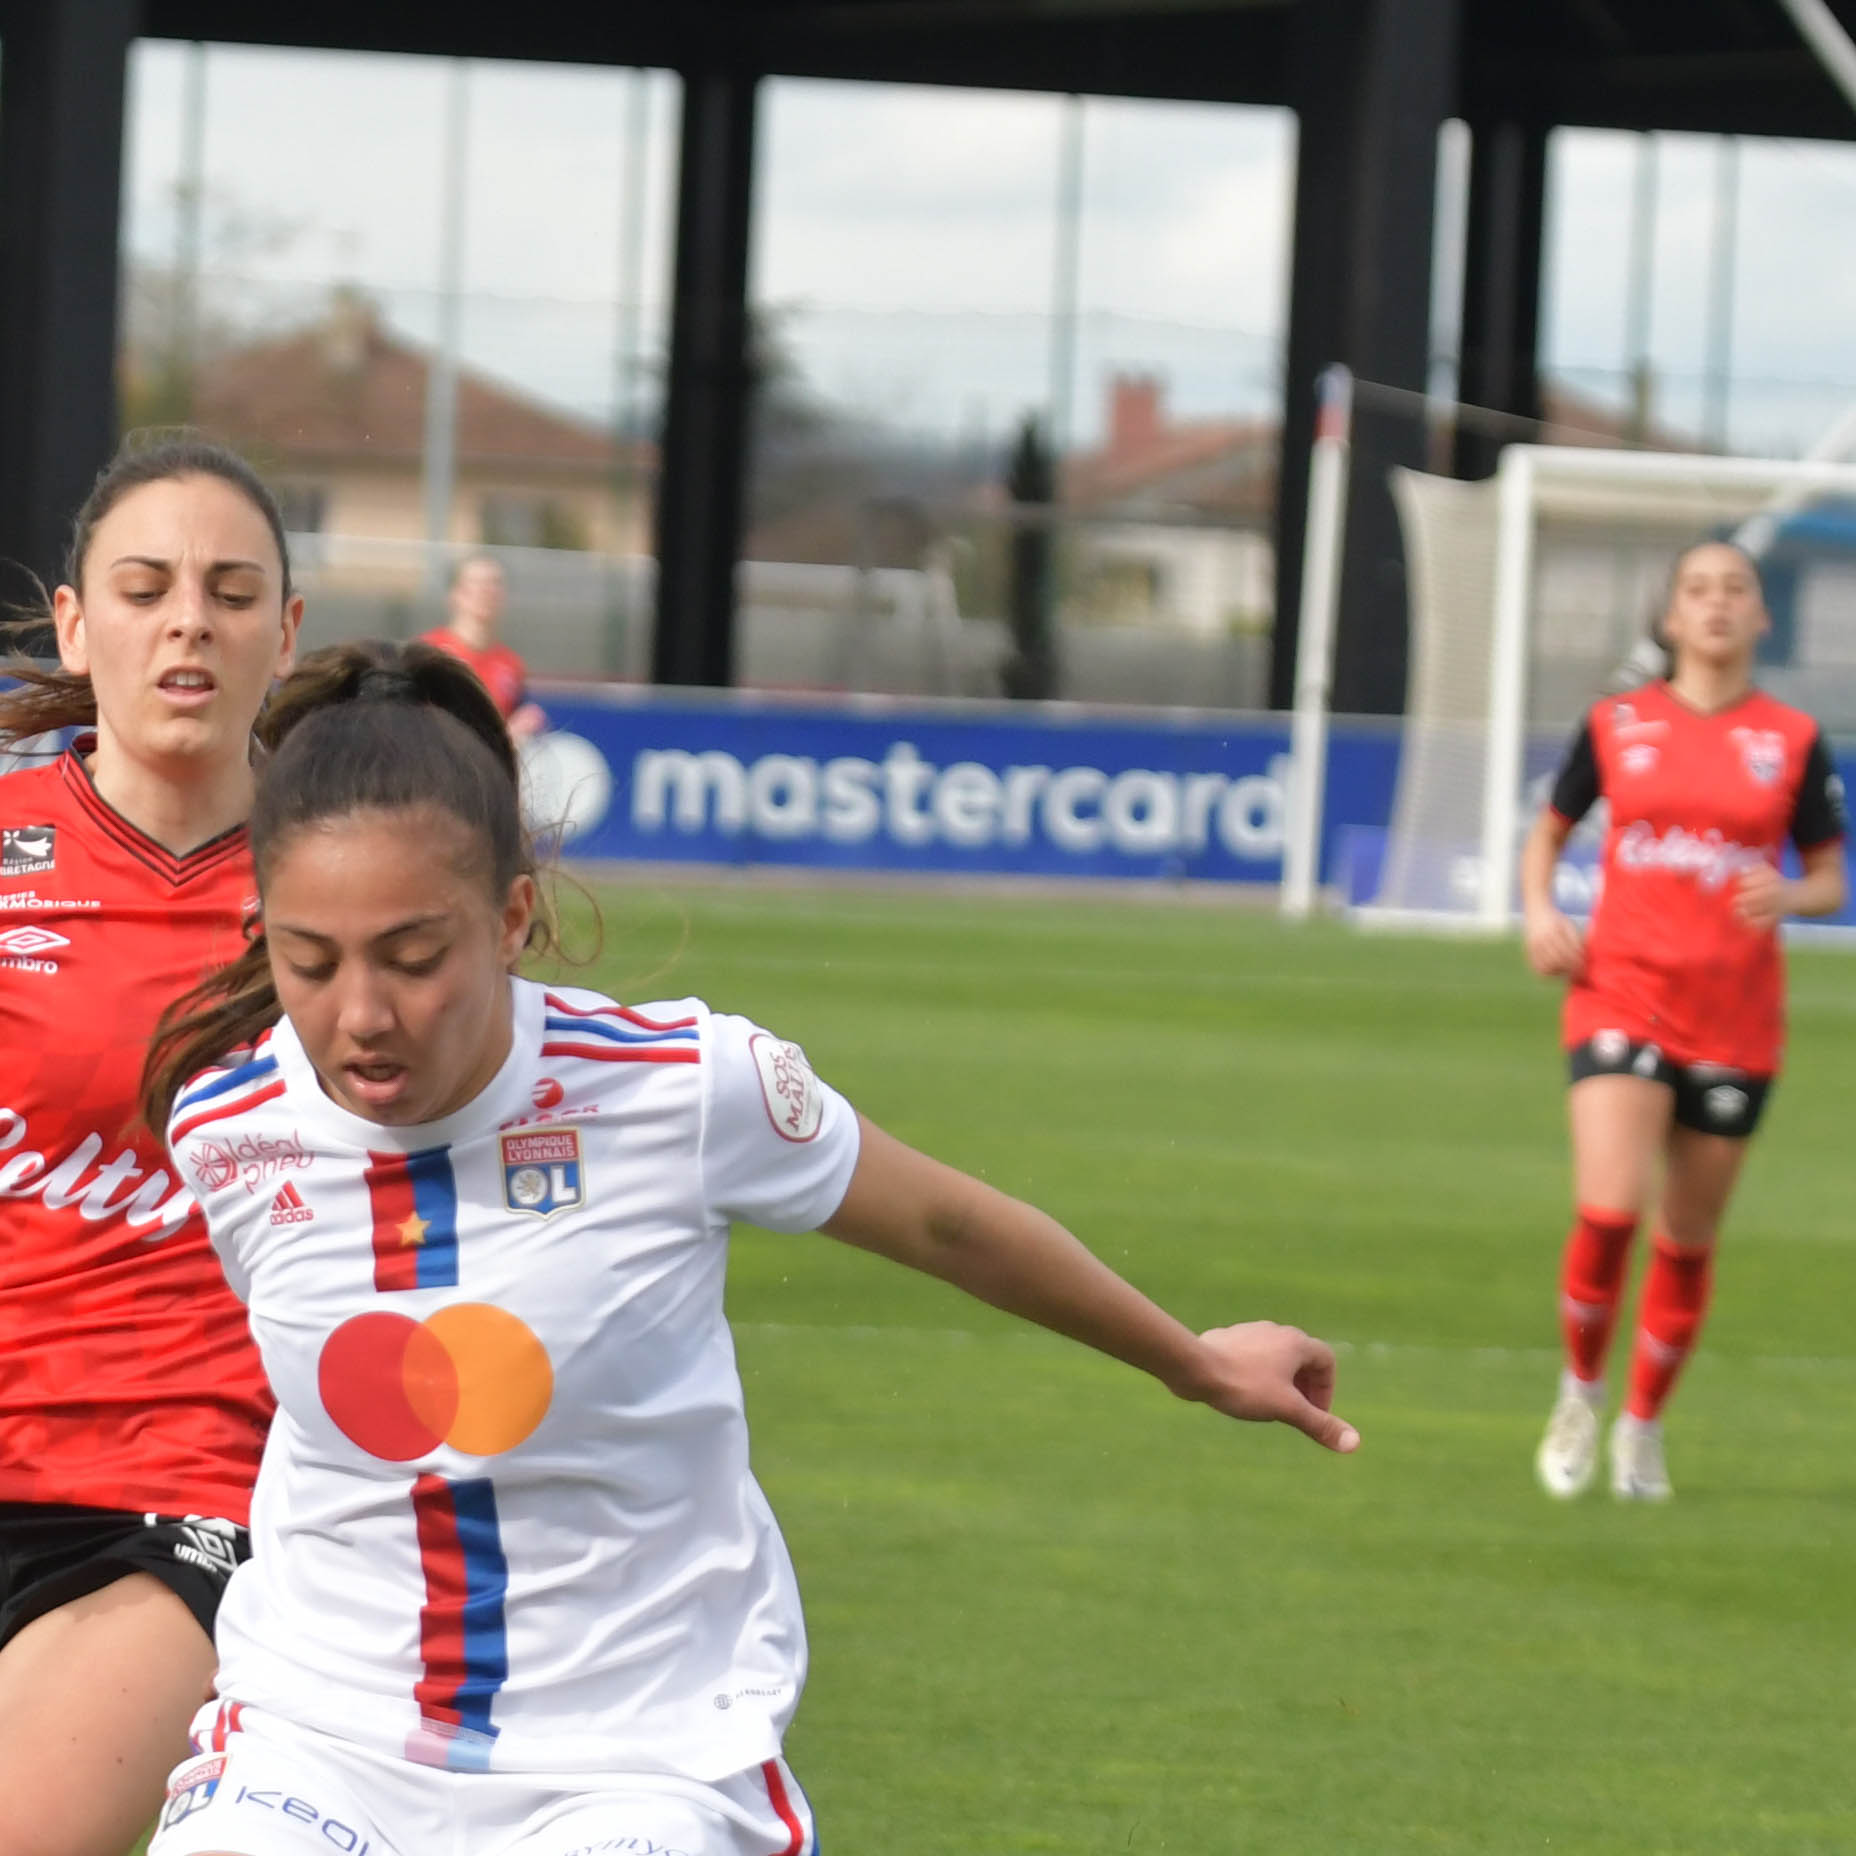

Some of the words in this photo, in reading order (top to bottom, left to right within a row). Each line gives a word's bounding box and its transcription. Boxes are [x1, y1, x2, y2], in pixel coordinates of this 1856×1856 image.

[631, 741, 1292, 860] mastercard
[506, 1135, 574, 1151] OLYMPIQUE
[507, 1146, 576, 1162] LYONNAIS
[510, 1164, 577, 1206] OL
